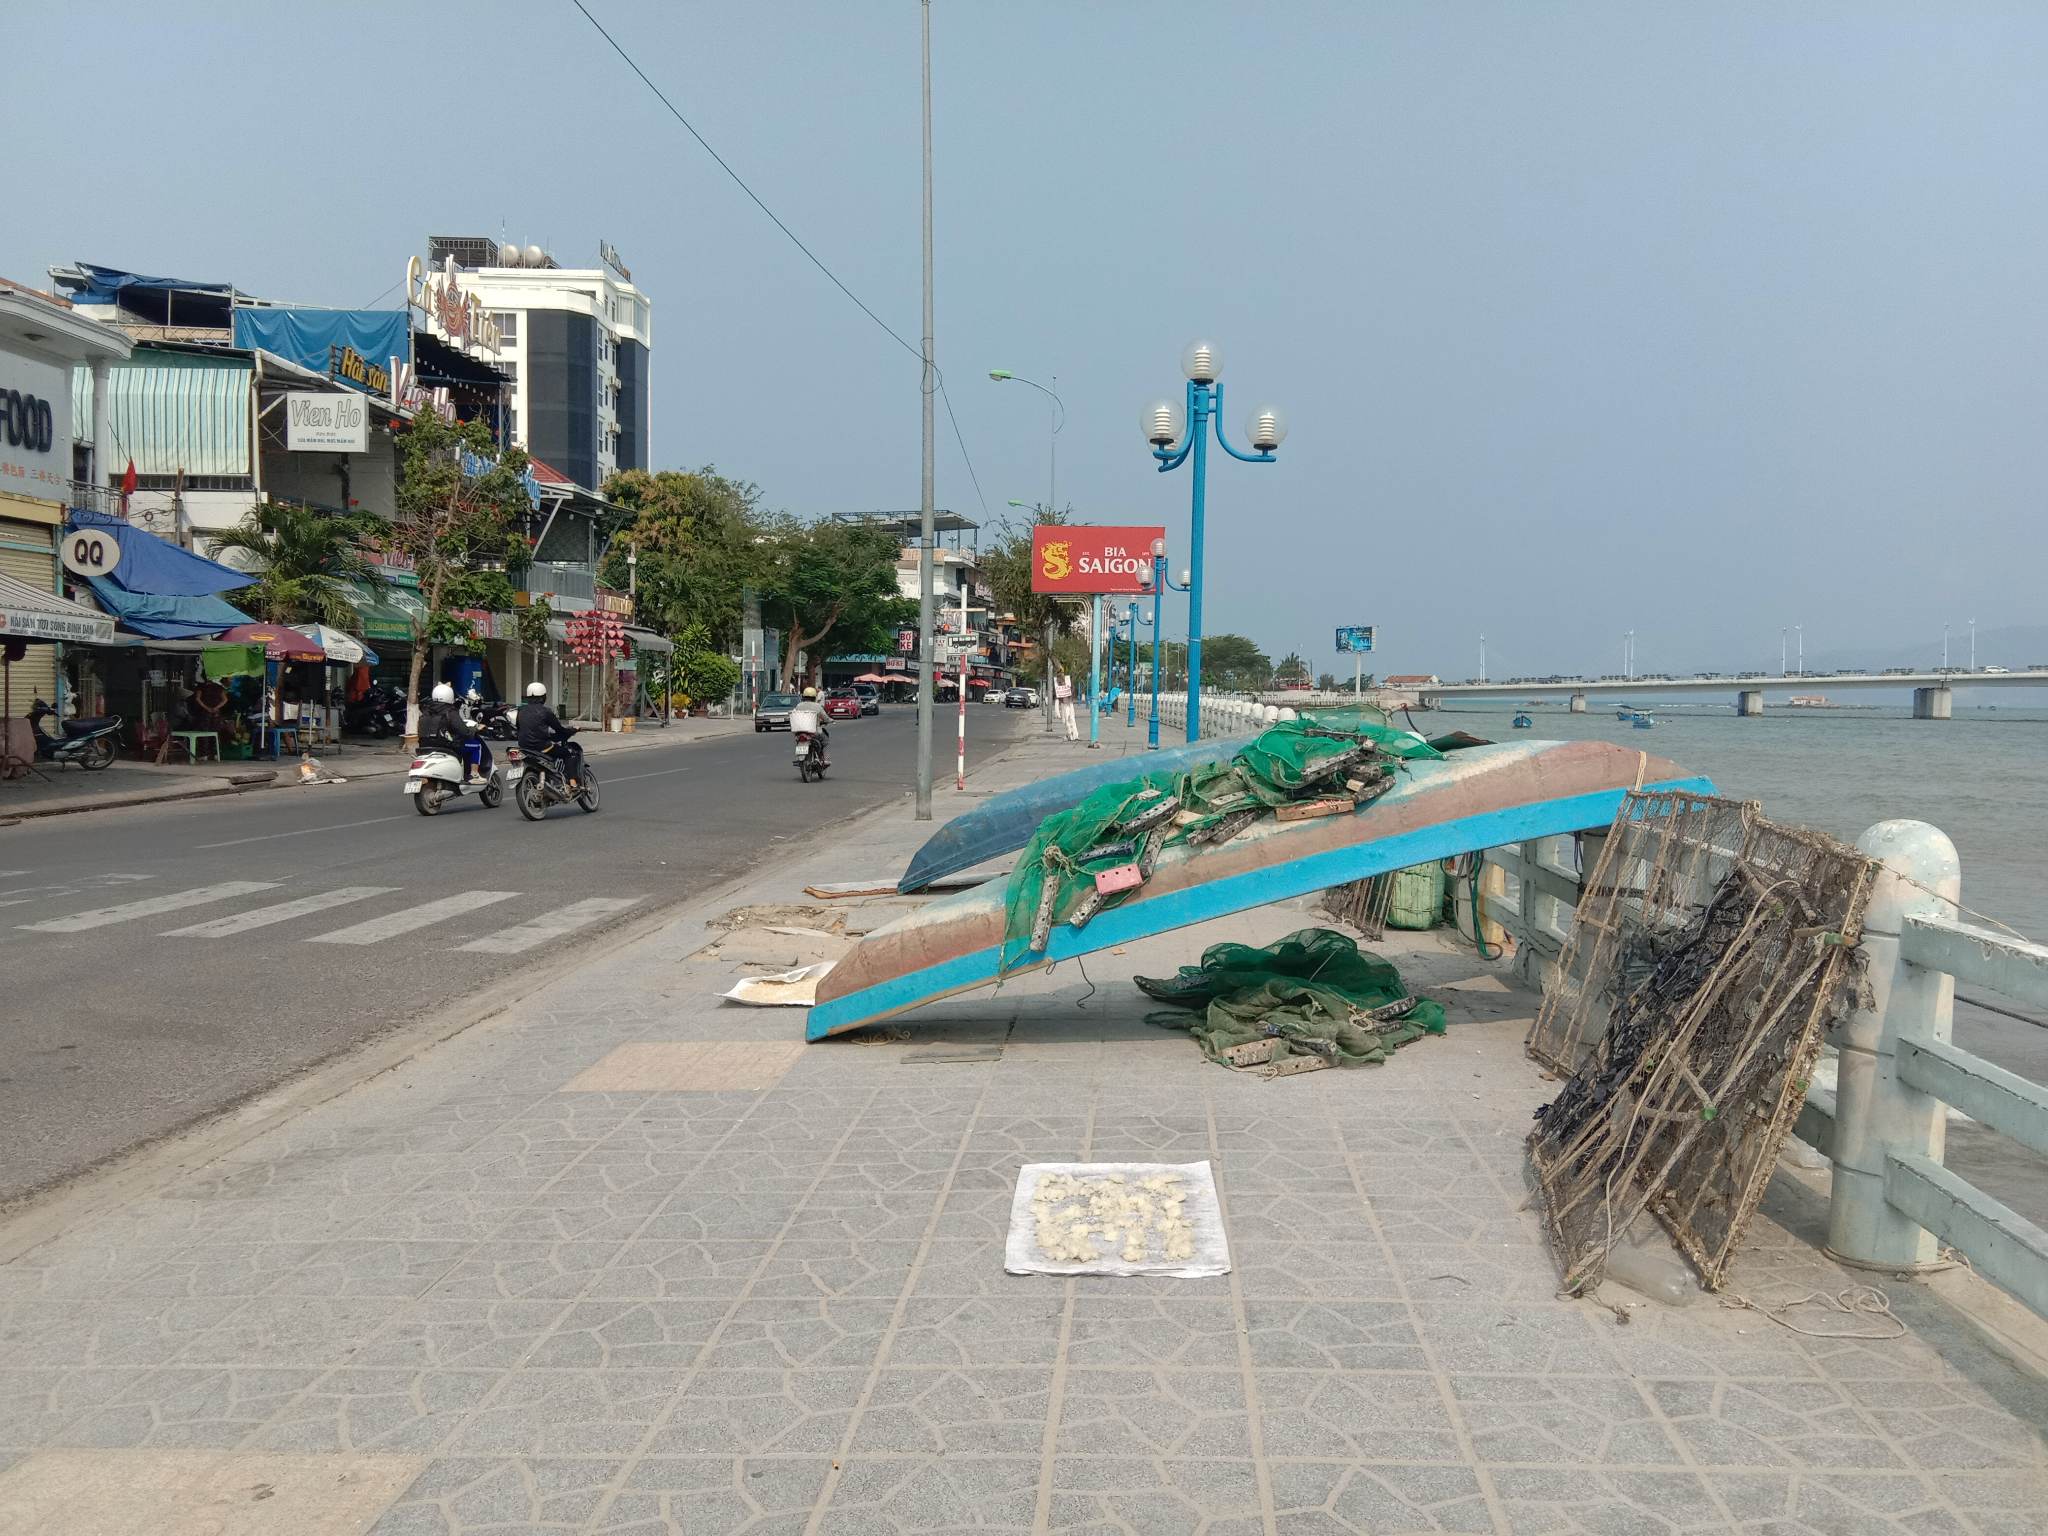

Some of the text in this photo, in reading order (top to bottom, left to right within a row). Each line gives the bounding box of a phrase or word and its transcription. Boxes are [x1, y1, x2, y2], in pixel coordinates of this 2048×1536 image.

[291, 399, 361, 429] Vien Ho
[74, 538, 104, 567] QQ
[1104, 546, 1127, 557] BIA
